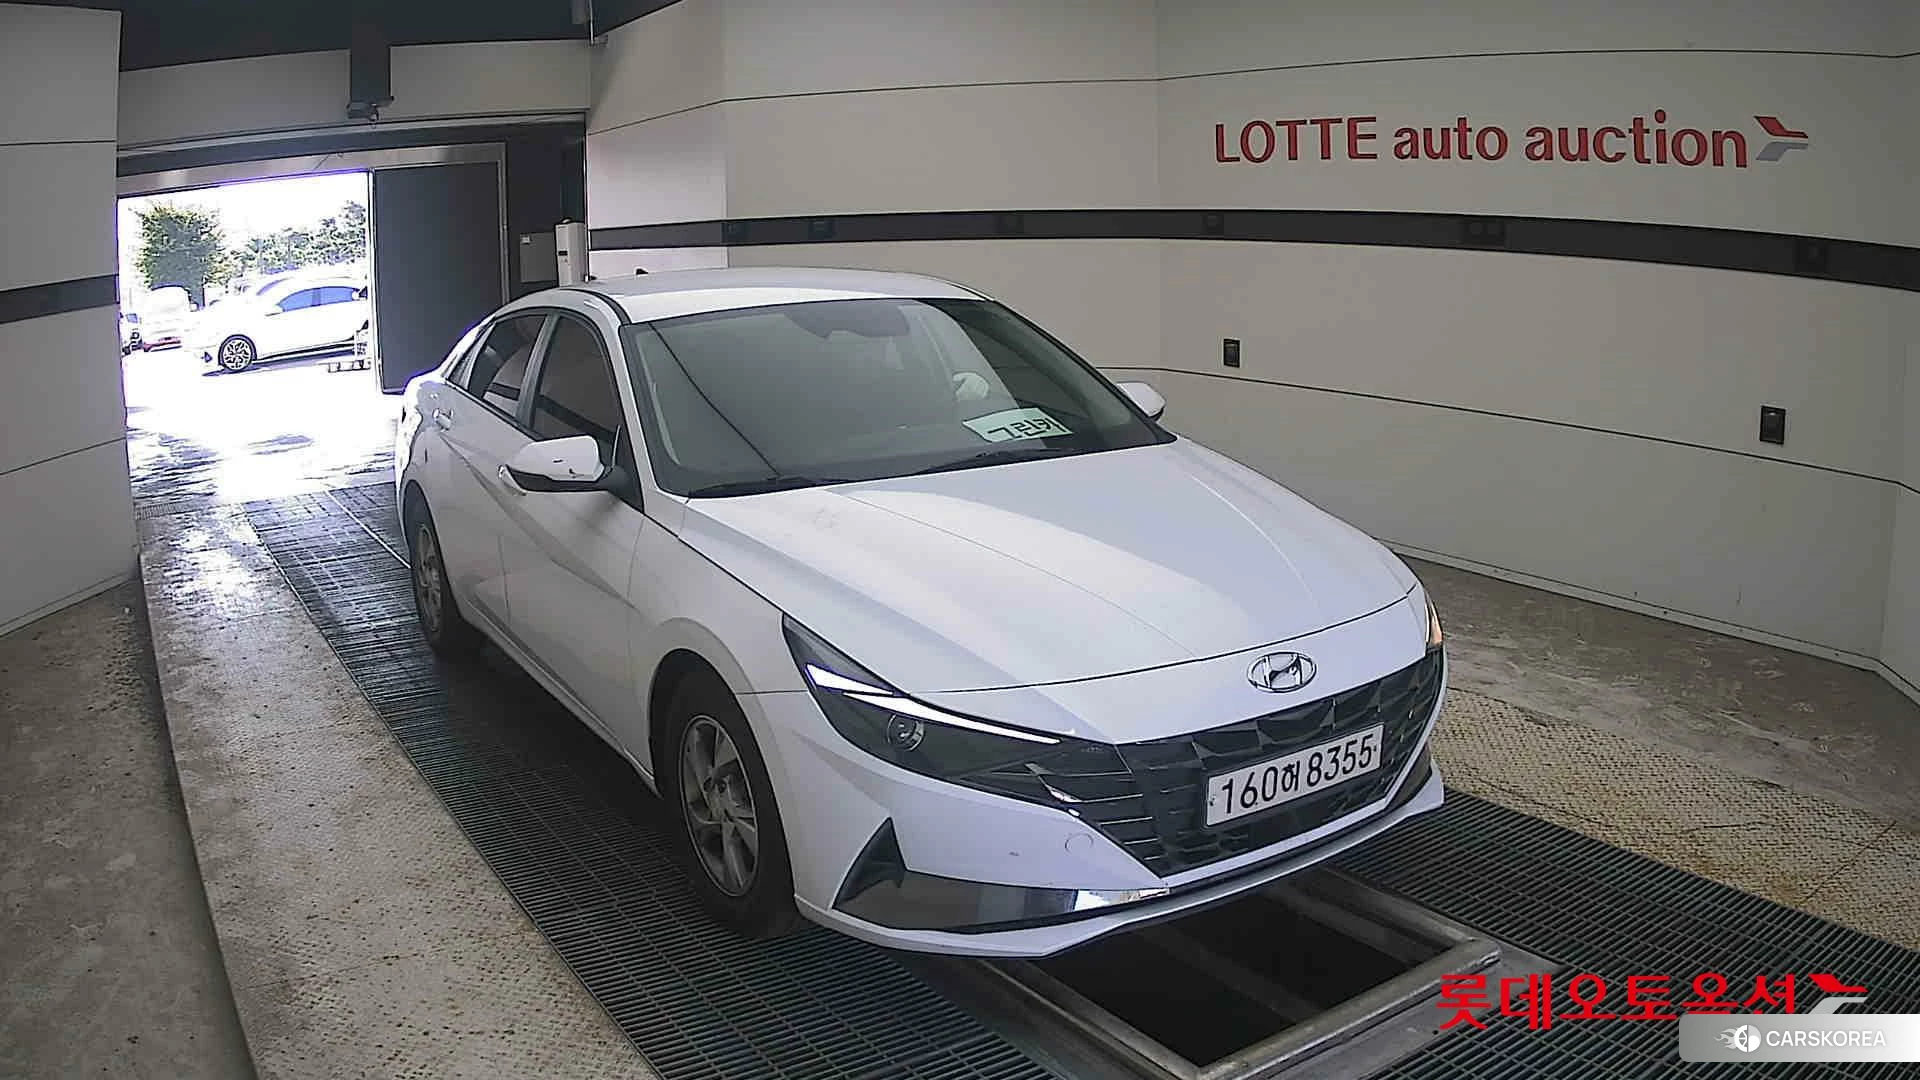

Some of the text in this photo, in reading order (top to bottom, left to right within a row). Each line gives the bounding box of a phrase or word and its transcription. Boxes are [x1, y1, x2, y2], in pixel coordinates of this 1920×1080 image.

[1215, 110, 1748, 167] LOTTE auto auction
